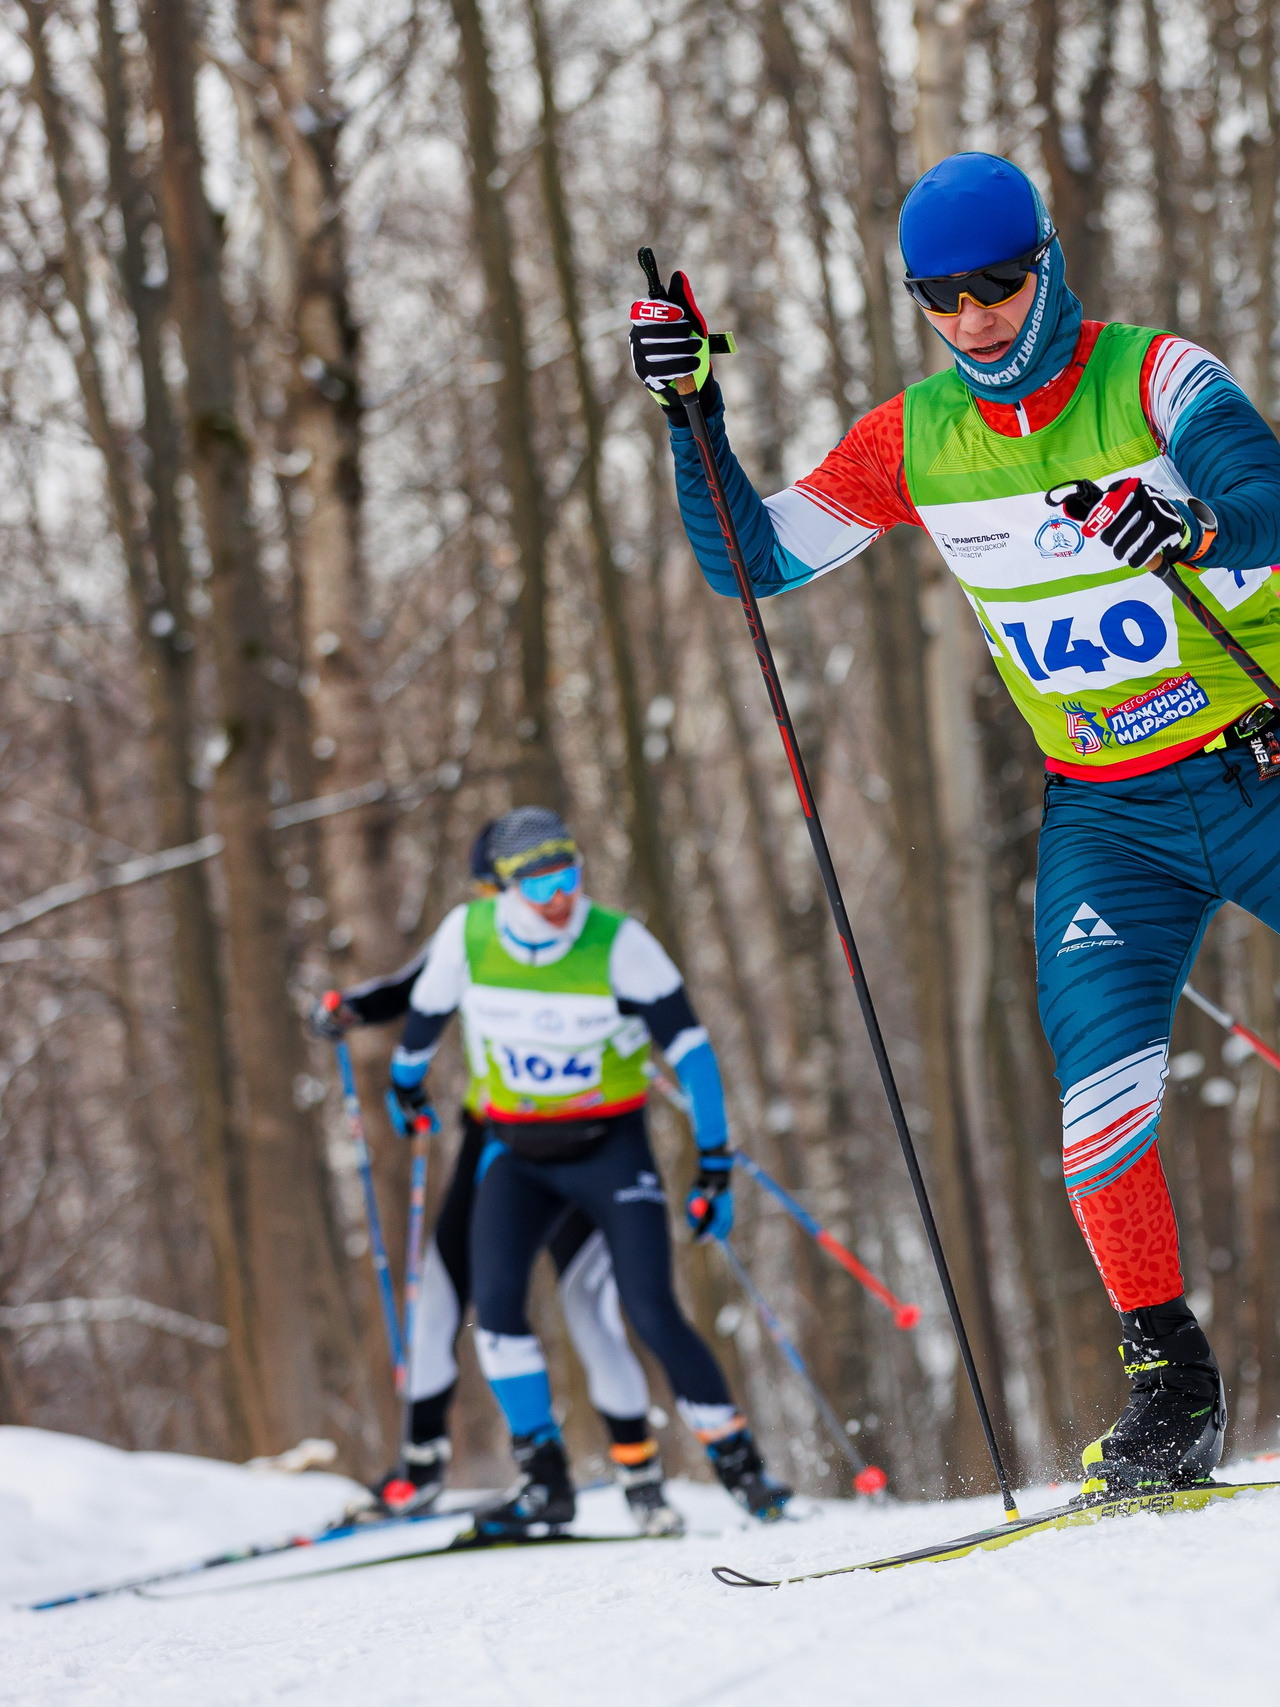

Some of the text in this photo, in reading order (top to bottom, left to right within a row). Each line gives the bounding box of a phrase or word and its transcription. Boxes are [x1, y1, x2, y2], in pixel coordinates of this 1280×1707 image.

[951, 532, 1010, 545] ПРАВИТЕЛЬСТВО
[1001, 600, 1168, 681] 140
[1111, 680, 1199, 732] ЛЫЖНЫЙ
[1117, 694, 1206, 745] МАРАФОН
[1056, 940, 1124, 957] FISCHER
[503, 1047, 593, 1082] 104
[1072, 1189, 1107, 1280] VICTORY
